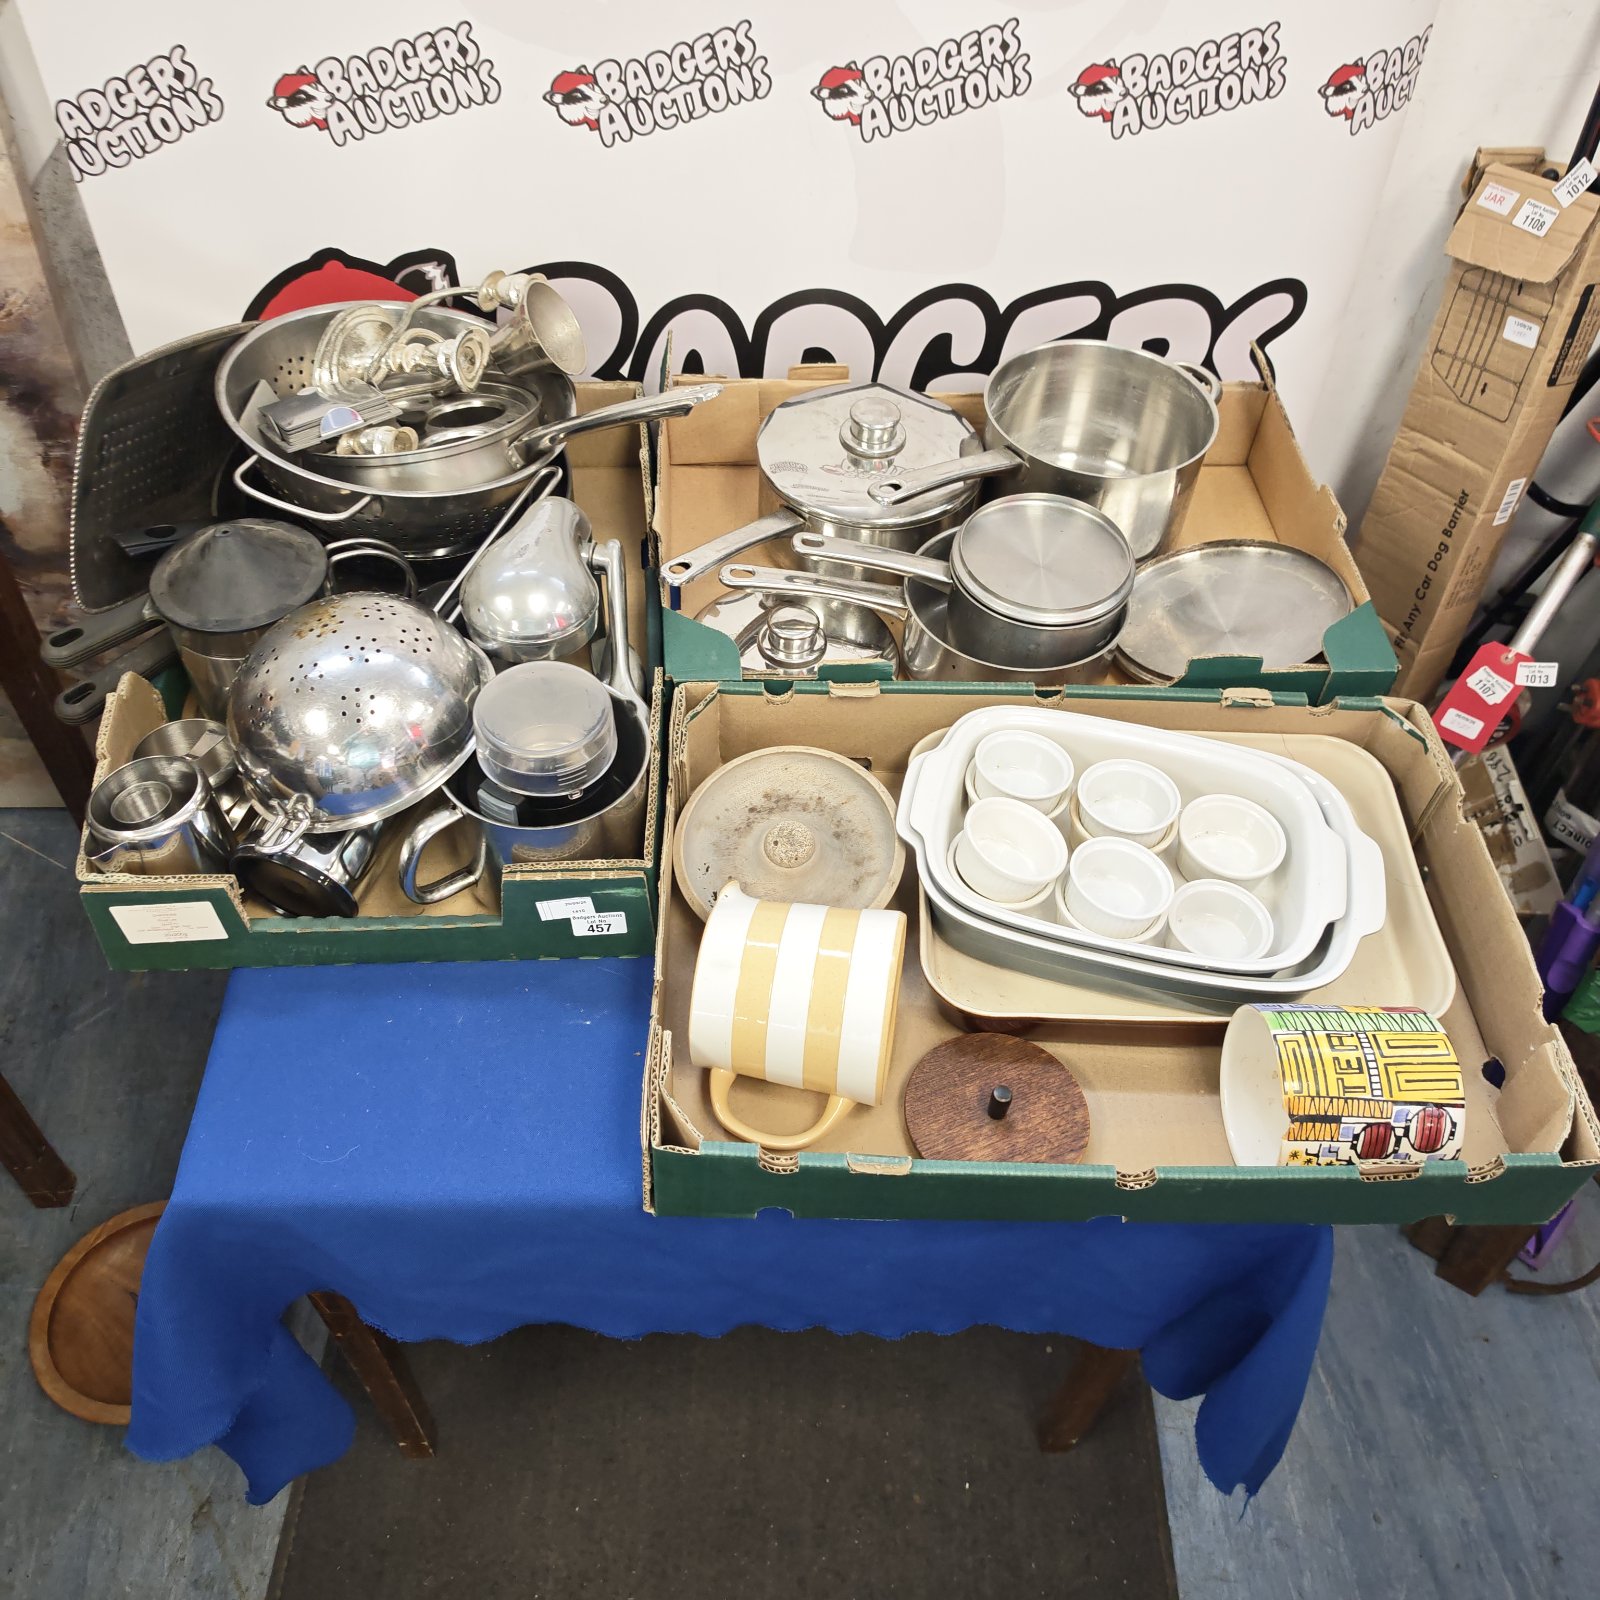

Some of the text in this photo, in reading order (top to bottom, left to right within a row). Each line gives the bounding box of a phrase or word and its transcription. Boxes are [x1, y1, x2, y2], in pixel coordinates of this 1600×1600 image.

[314, 20, 480, 104] BADGERS
[593, 19, 756, 105] BADGERS
[860, 53, 1032, 143] AUCTIONS
[862, 17, 1021, 101] BADGERS
[1111, 56, 1287, 140] AUCTIONS
[1120, 20, 1281, 98] BADGERS
[326, 58, 502, 147] AUCTIONS
[598, 55, 772, 148] AUCTIONS
[1484, 191, 1506, 206] JAR
[1522, 214, 1546, 232] 1108
[1566, 173, 1591, 198] 1012
[1403, 604, 1422, 633] Any
[1415, 574, 1432, 602] Car
[1427, 540, 1449, 572] Dog
[1441, 488, 1470, 539] Barrier
[1475, 679, 1496, 697] 1107
[1525, 674, 1549, 684] 1013
[587, 923, 612, 933] 457
